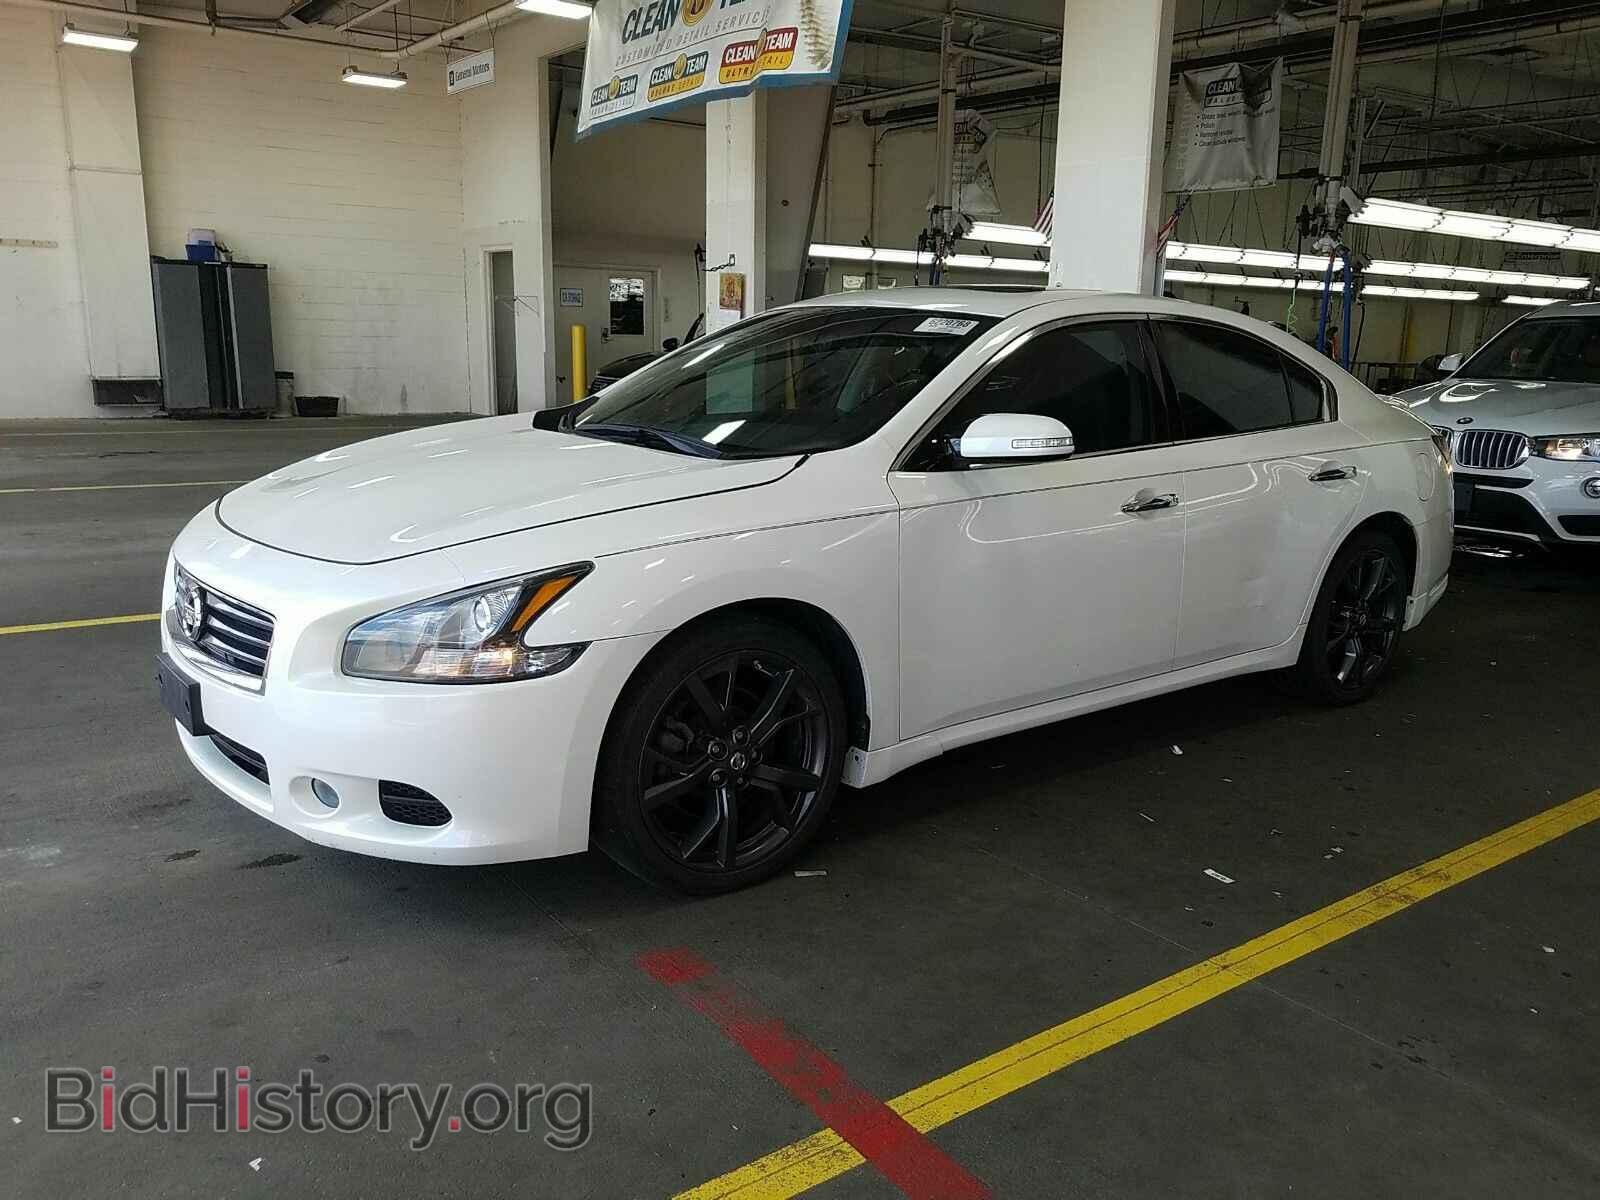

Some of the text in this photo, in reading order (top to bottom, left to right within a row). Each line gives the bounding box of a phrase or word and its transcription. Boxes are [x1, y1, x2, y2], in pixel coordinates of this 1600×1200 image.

[725, 32, 794, 63] CLEAN TEAM
[651, 55, 706, 84] CLEAN TEAM
[592, 88, 608, 105] CLEAN
[619, 78, 636, 97] TEAM
